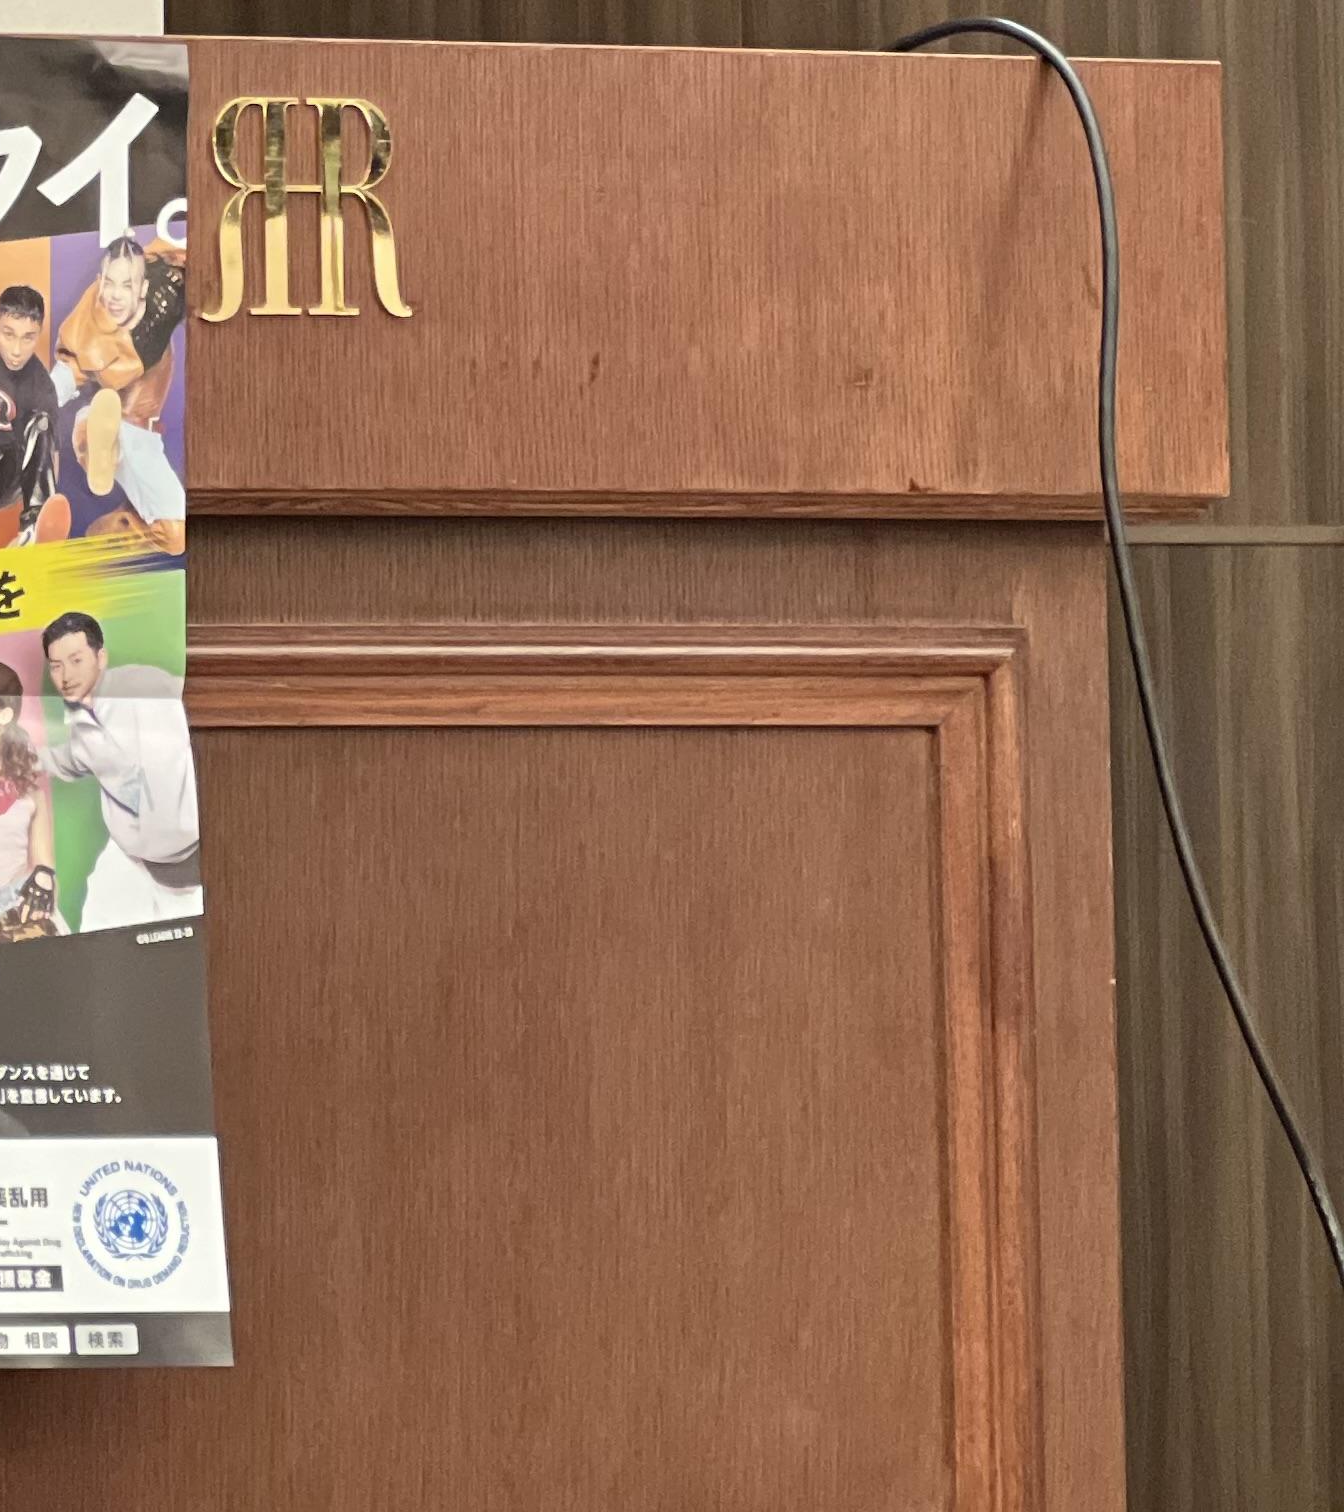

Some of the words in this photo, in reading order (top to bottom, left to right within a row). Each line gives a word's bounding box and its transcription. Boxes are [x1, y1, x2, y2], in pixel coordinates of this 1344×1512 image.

[79, 1161, 120, 1196] UNITED
[124, 1160, 178, 1196] NATIONS
[24, 1332, 59, 1350] 相談
[87, 1331, 124, 1349] 検索
